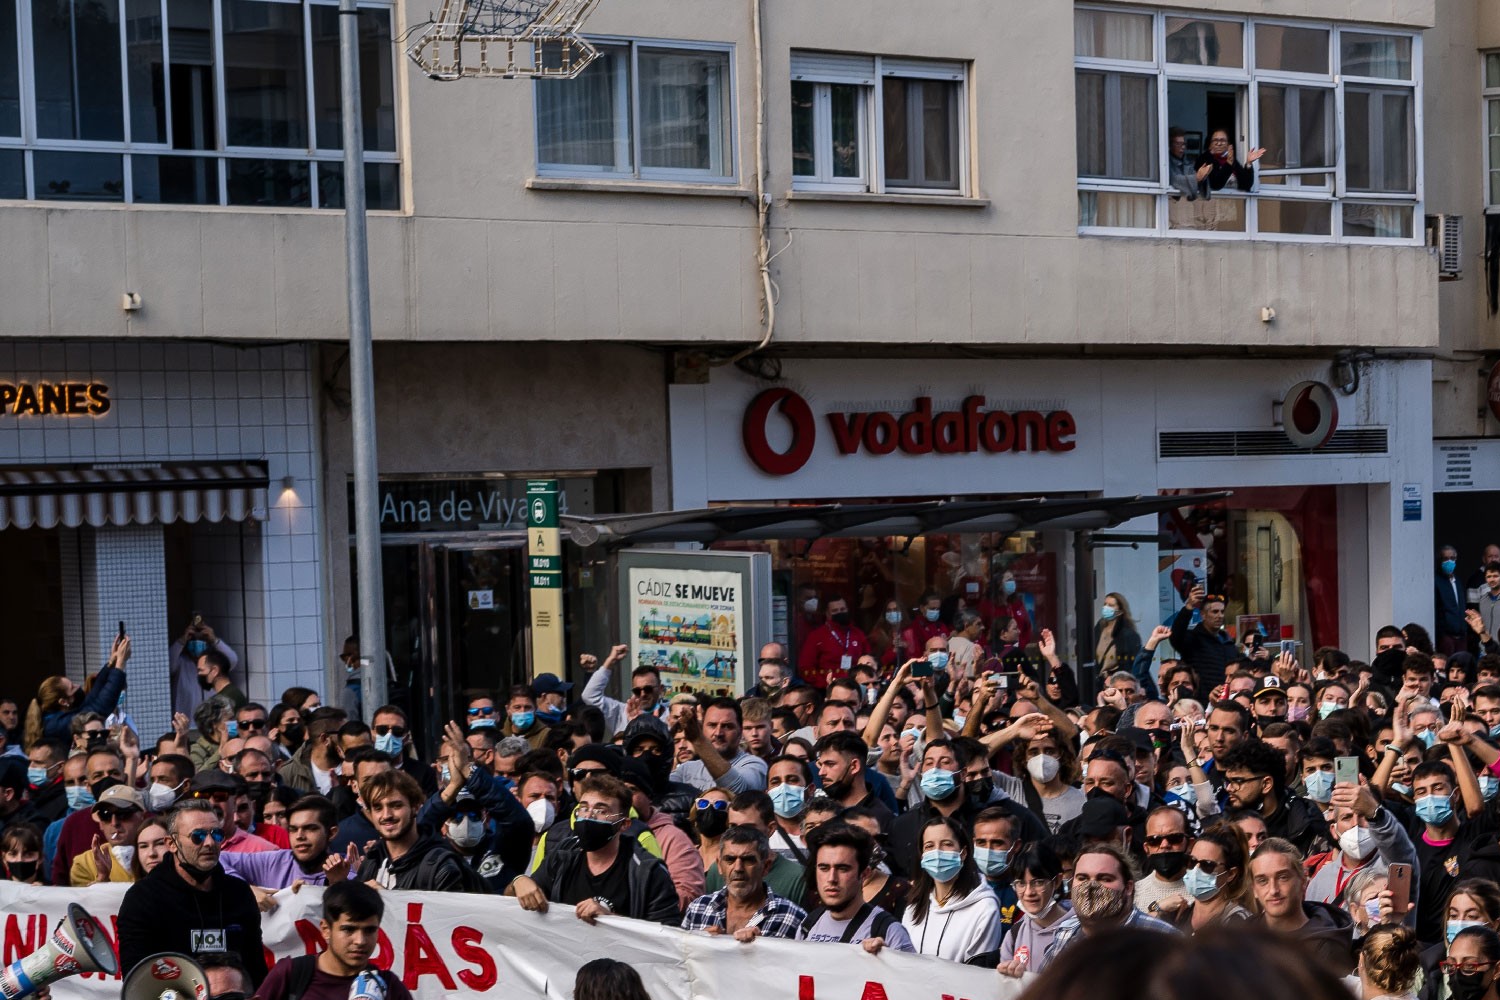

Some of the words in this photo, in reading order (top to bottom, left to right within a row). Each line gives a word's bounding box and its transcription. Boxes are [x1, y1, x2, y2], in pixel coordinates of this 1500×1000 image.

[827, 395, 1077, 455] vodafone
[380, 492, 431, 523] Ana
[439, 490, 473, 522] de
[637, 578, 672, 598] CÁDIZ
[675, 583, 689, 600] SE
[691, 584, 735, 603] MUEVE
